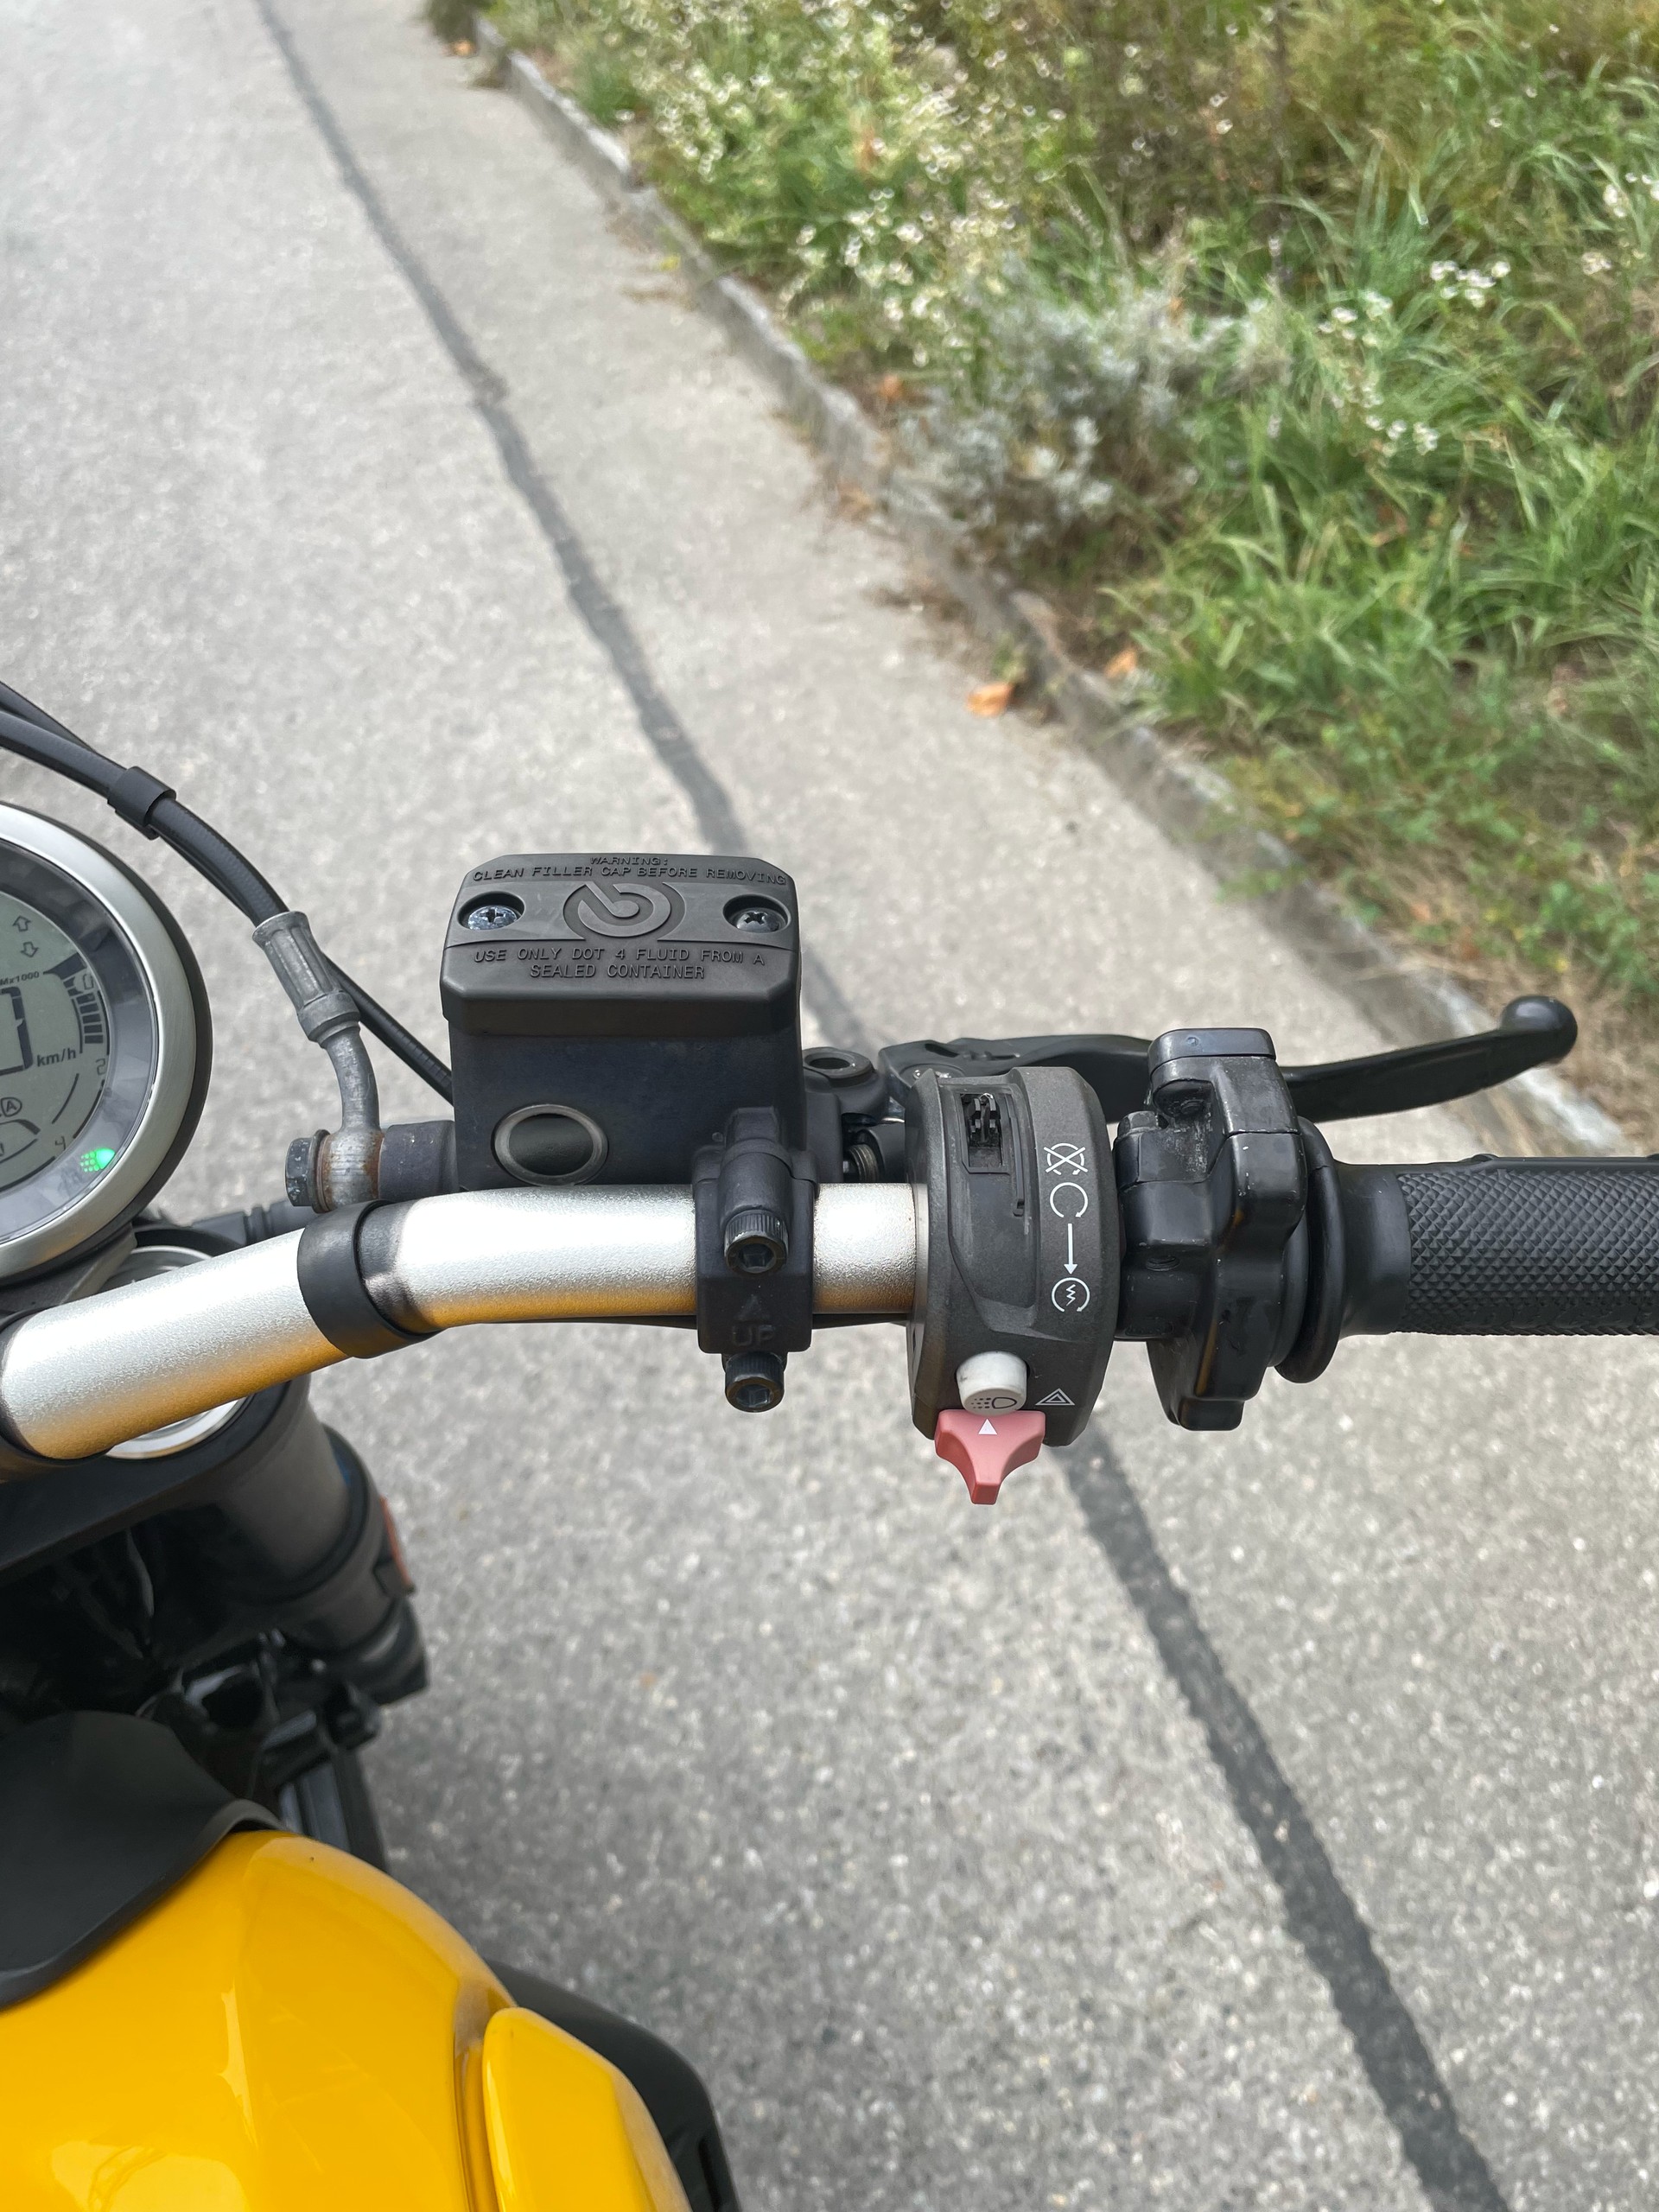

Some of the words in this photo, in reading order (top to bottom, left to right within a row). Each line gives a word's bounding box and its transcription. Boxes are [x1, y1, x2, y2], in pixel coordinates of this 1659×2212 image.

[474, 868, 524, 881] CLEAN
[531, 867, 593, 877] FILLER
[601, 867, 632, 876] CAP
[637, 867, 698, 878] BEFORE
[706, 868, 787, 885] REMOVING
[474, 950, 507, 963] USE
[518, 948, 562, 960] ONLY
[572, 948, 605, 960] DOT
[615, 949, 626, 960] 4
[636, 949, 690, 961] FLUID
[701, 950, 744, 963] FROM
[753, 953, 766, 965] A
[530, 964, 596, 978] SEALED
[607, 964, 705, 979] CONTAINER
[36, 1047, 77, 1067] km/h
[731, 1325, 775, 1347] UP
